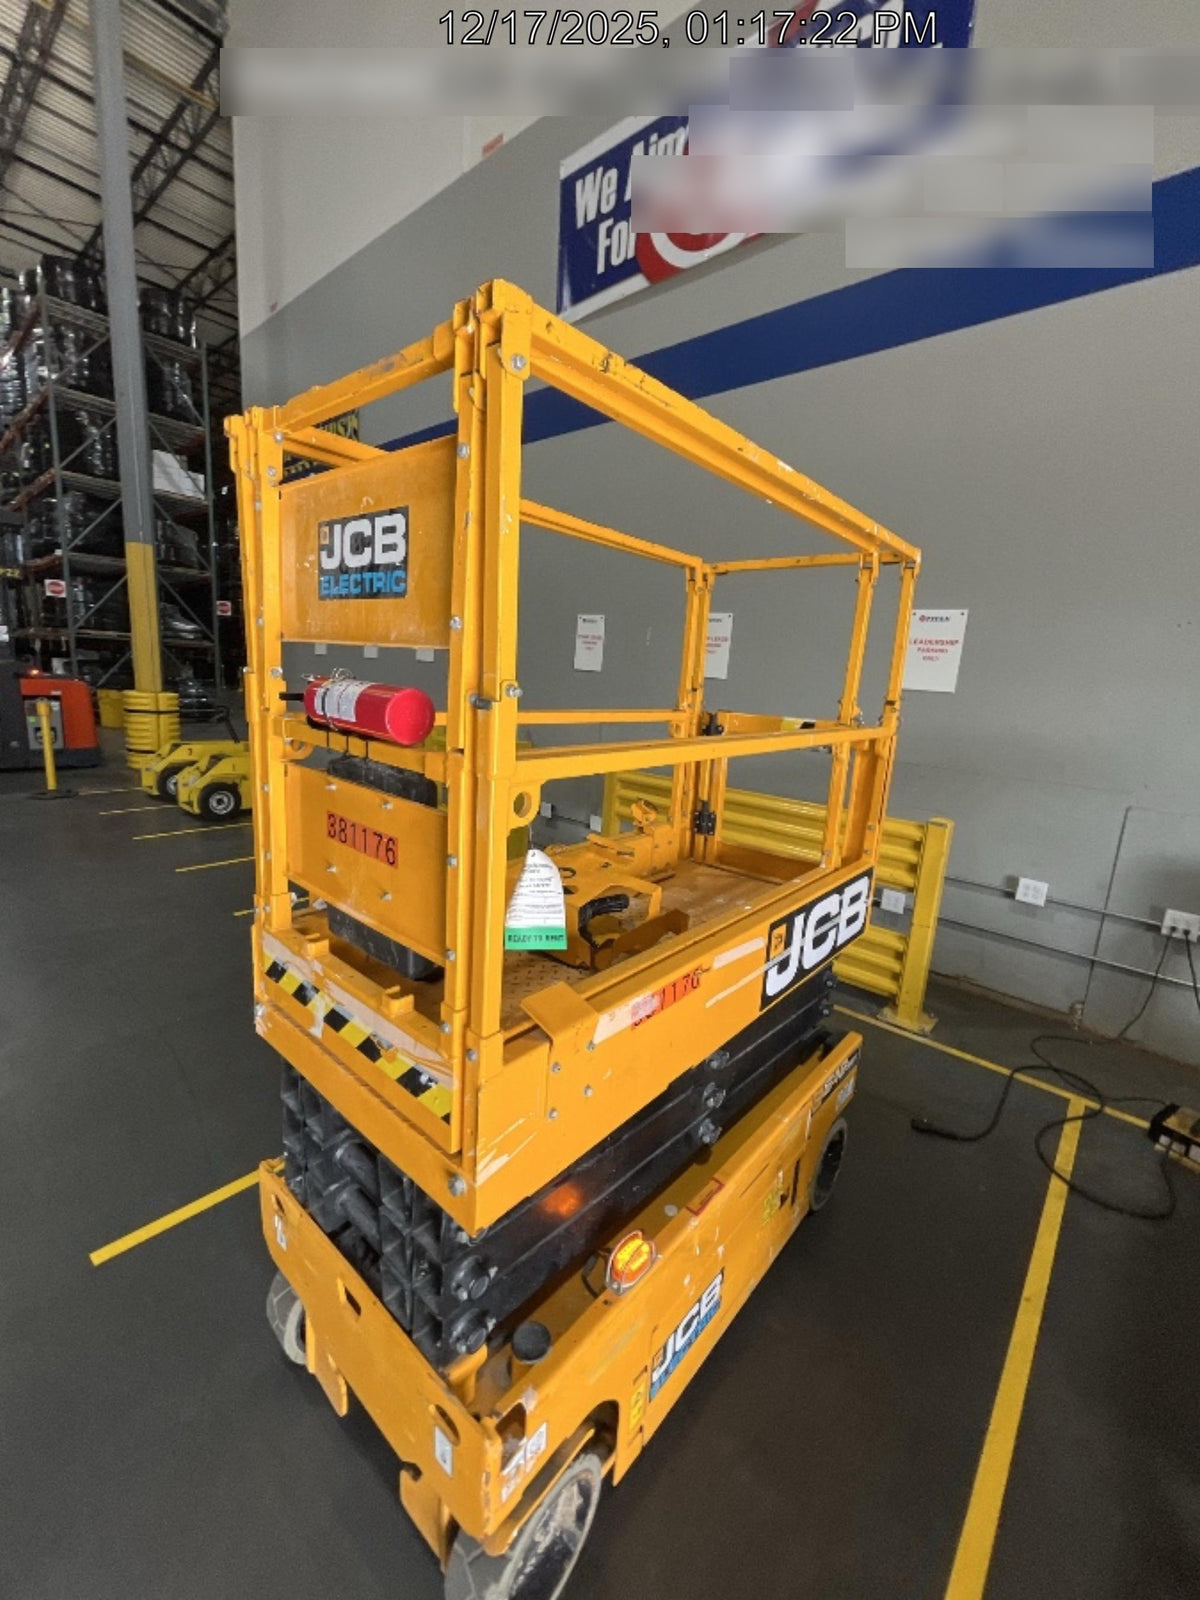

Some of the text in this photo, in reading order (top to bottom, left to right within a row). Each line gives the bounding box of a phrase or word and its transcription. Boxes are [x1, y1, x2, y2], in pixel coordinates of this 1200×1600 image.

[575, 166, 618, 230] We
[320, 513, 407, 570] JCB
[321, 569, 406, 596] ELECTRIC
[327, 813, 396, 866] 381176
[765, 876, 870, 997] JCB
[632, 965, 702, 1027] 1176
[651, 1273, 722, 1383] JCB
